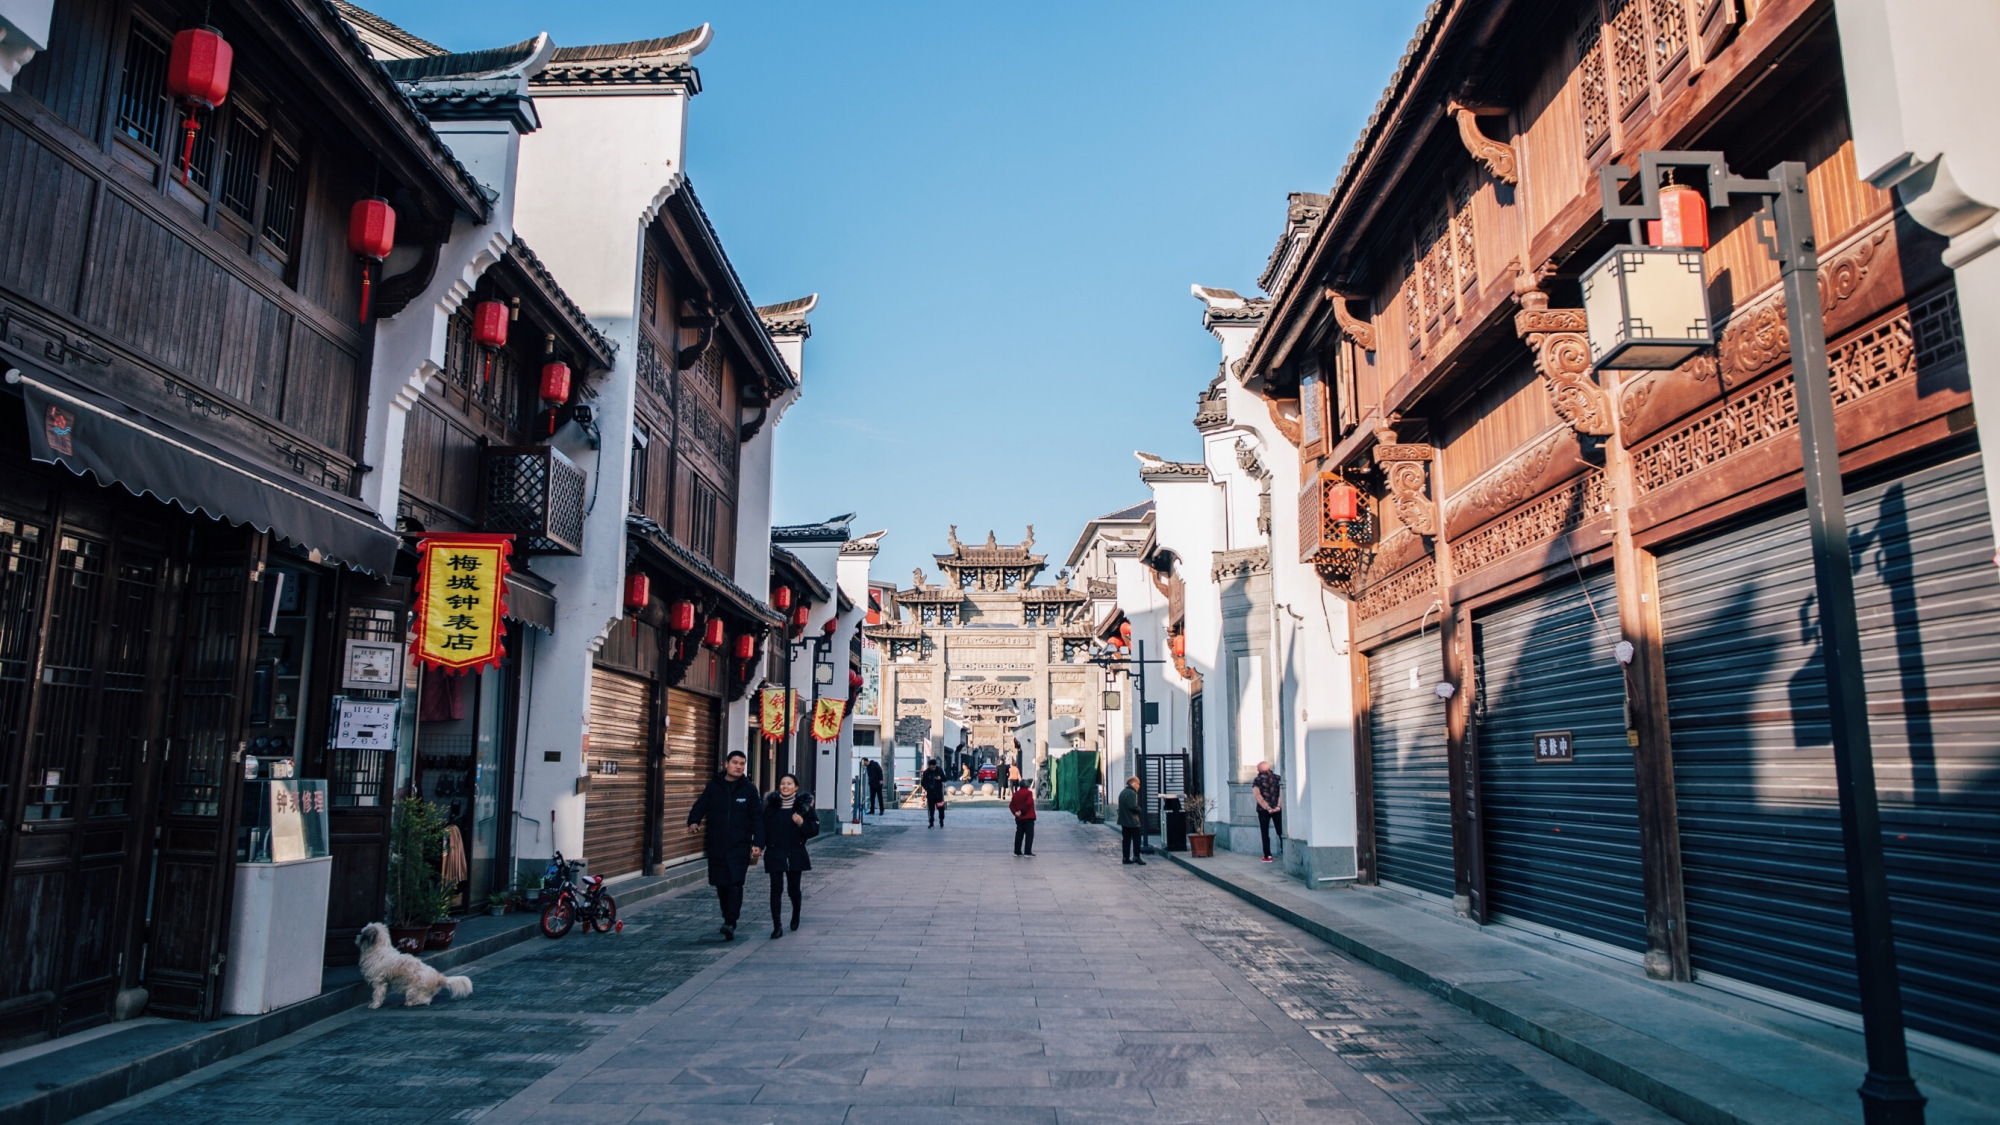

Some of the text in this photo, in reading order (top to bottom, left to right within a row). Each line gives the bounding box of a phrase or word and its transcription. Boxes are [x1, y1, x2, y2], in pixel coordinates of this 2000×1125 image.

[441, 554, 482, 651] 梅城钟表店
[381, 722, 389, 730] 3
[381, 732, 387, 740] 4
[276, 789, 325, 815] 钟表修理
